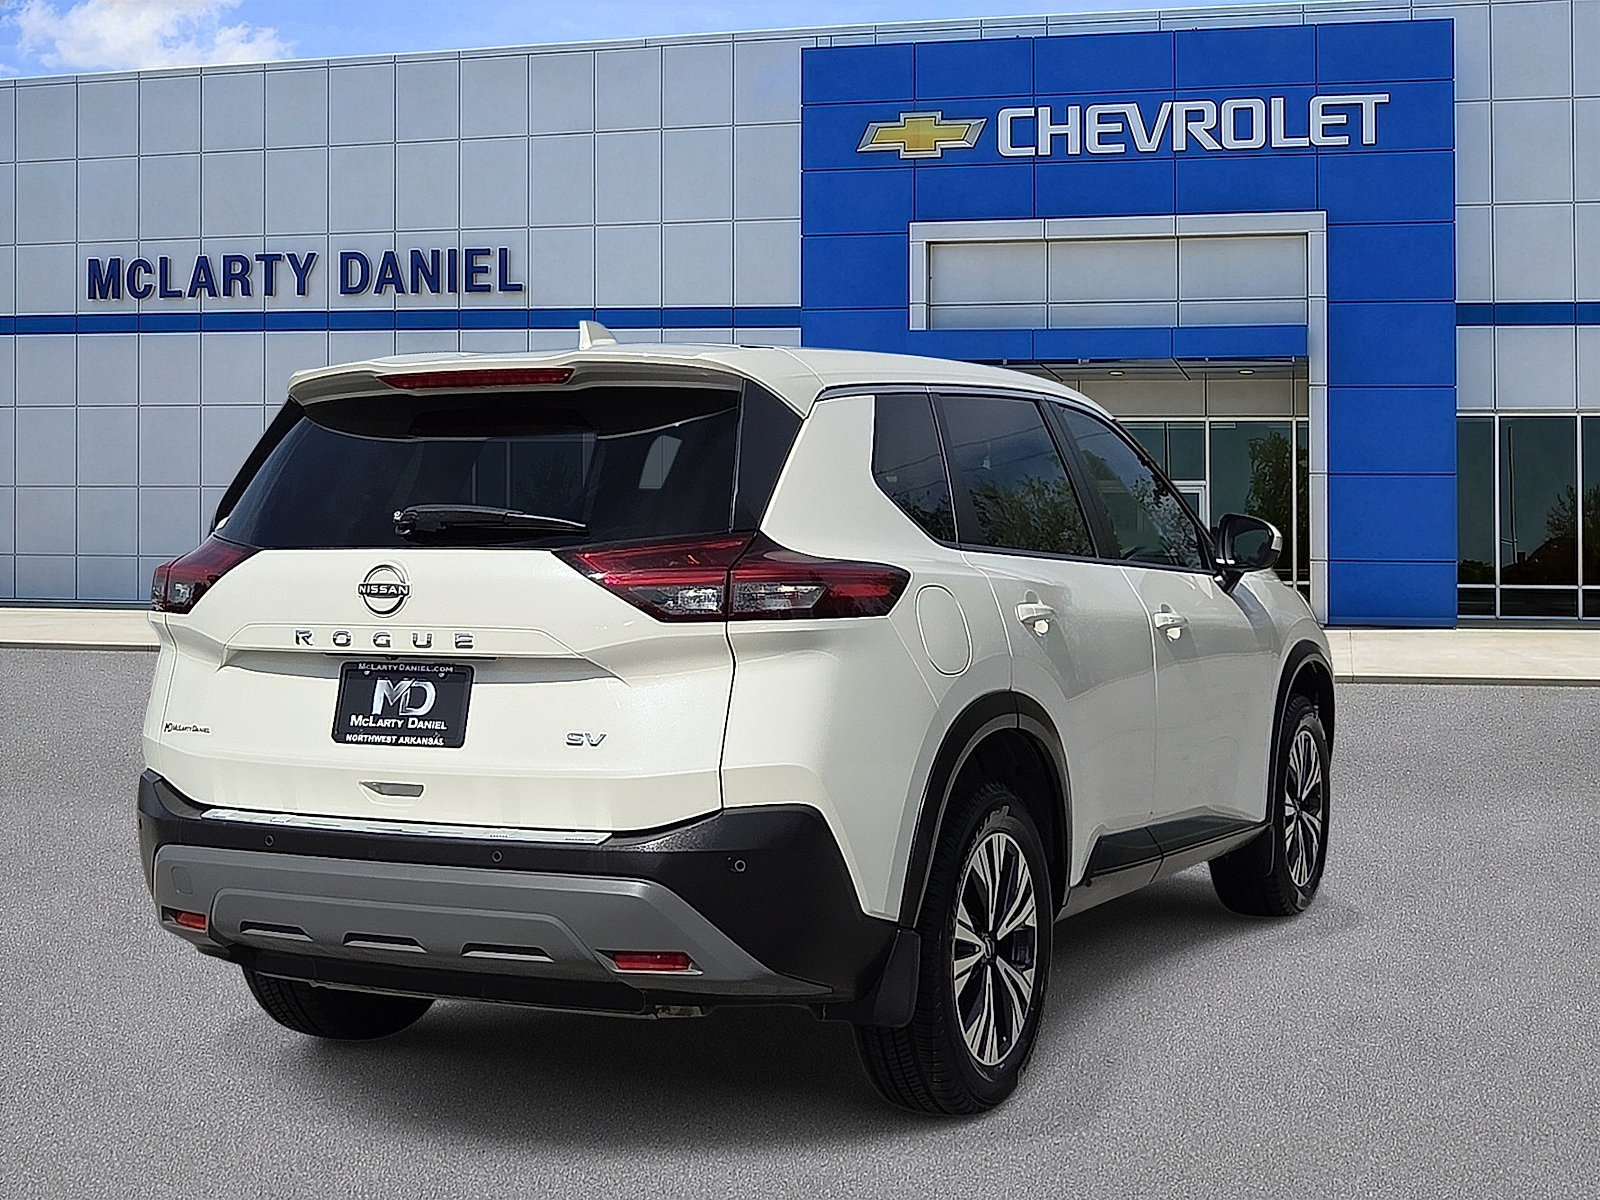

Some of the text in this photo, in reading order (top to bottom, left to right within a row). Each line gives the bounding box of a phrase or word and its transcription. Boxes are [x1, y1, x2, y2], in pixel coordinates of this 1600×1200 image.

[998, 93, 1390, 157] CHEVROLET
[338, 246, 525, 296] DANIEL
[358, 584, 409, 596] NISSAN
[295, 629, 474, 649] ROGUE
[407, 717, 447, 730] DANIEL
[345, 733, 445, 746] NORTHWEST ARKANSAS
[565, 732, 607, 747] SV
